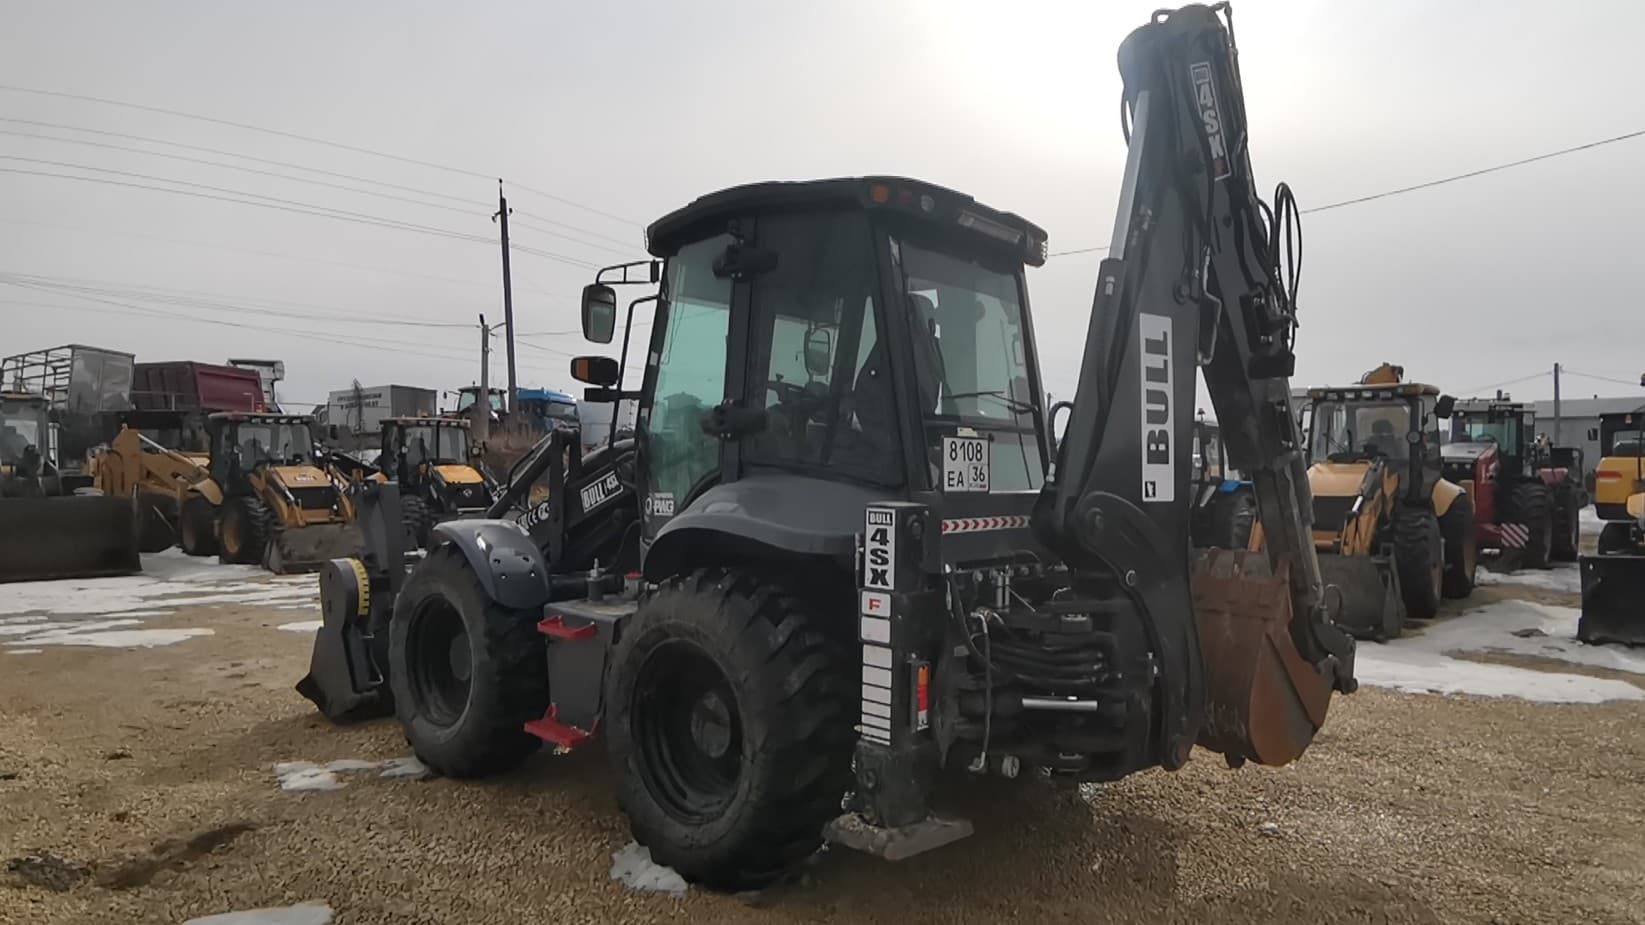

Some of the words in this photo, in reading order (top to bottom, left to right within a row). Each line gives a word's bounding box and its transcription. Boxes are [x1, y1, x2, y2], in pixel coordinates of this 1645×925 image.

[1144, 331, 1170, 465] BULL
[949, 440, 983, 462] 8108
[947, 470, 965, 487] EA
[972, 465, 986, 482] 36
[869, 512, 892, 525] BULL
[869, 527, 890, 587] 4SX
[869, 598, 881, 610] F
